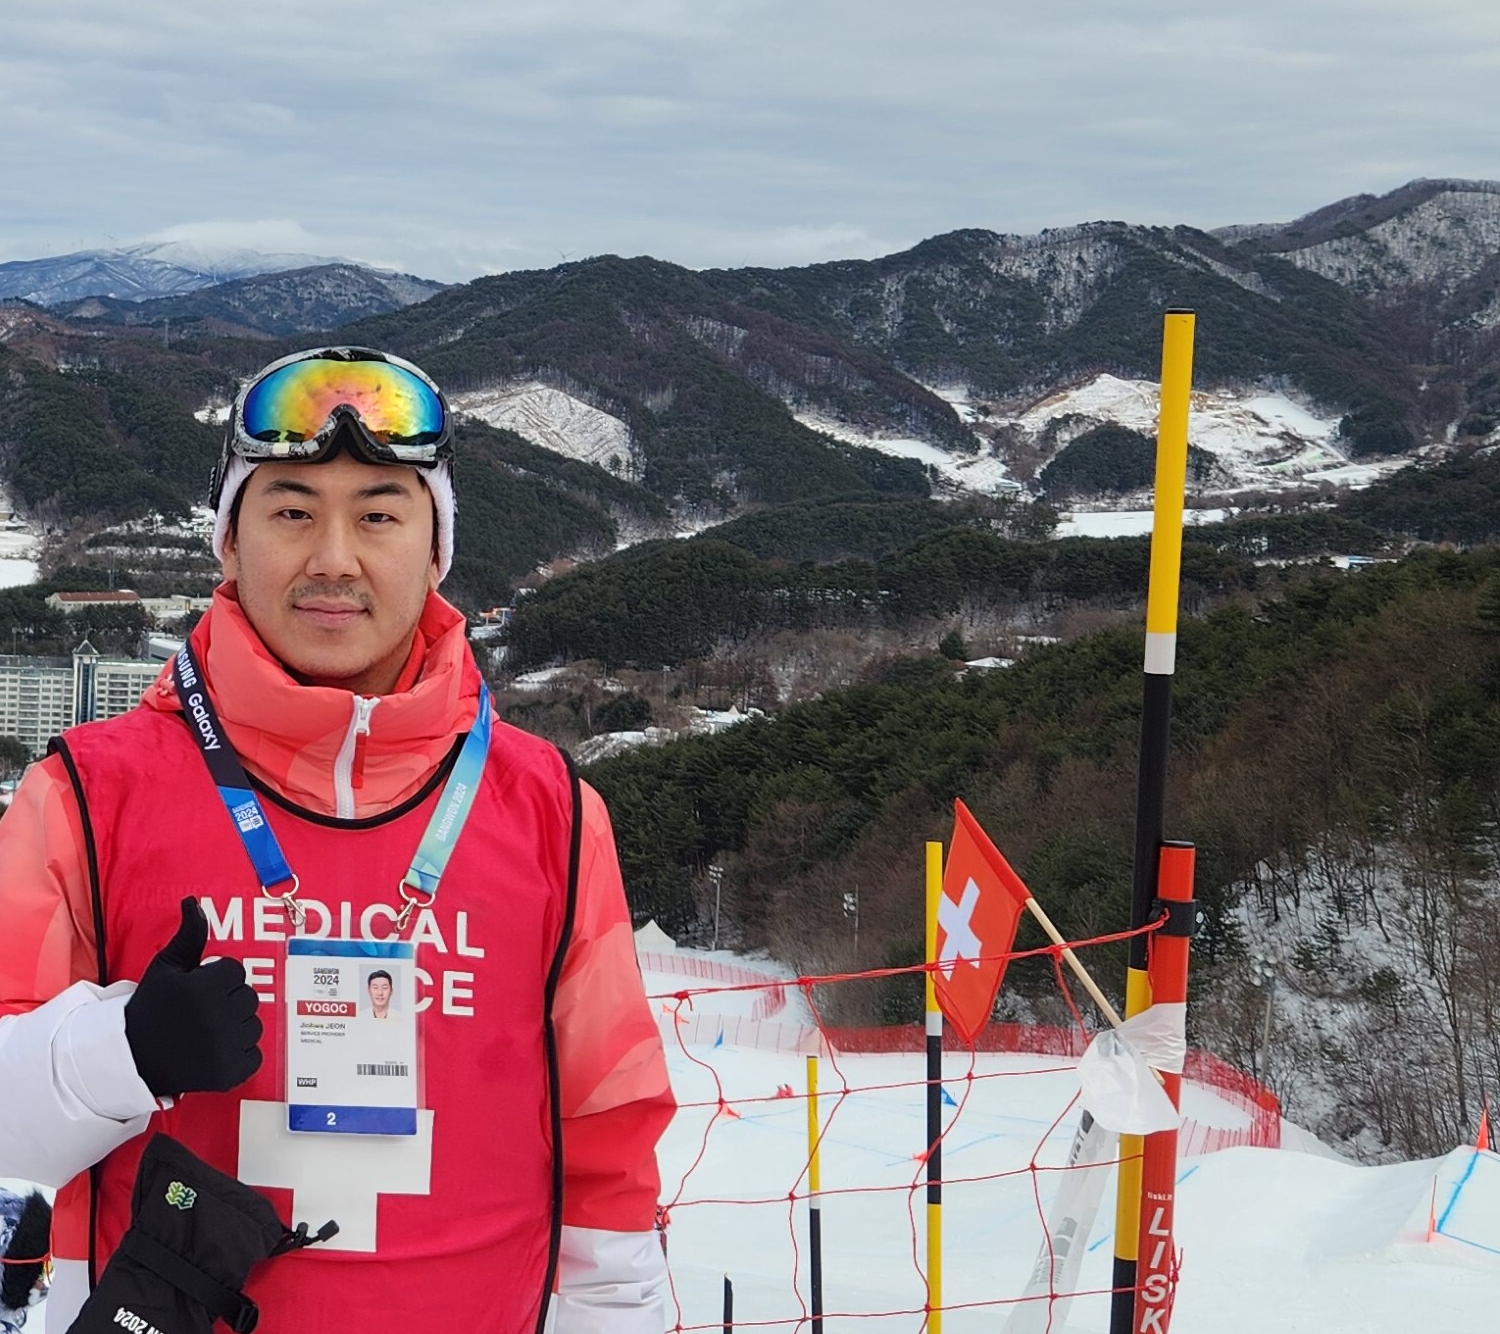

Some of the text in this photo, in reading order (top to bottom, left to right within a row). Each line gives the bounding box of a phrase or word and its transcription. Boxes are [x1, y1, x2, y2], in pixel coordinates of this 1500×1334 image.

[188, 693, 221, 750] Galaxy
[234, 806, 259, 822] 2024
[200, 896, 485, 958] MEDICAL
[313, 975, 340, 986] 2024
[305, 1002, 348, 1014] YOGOC
[326, 1112, 336, 1126] 2
[113, 1307, 148, 1334] 2024
